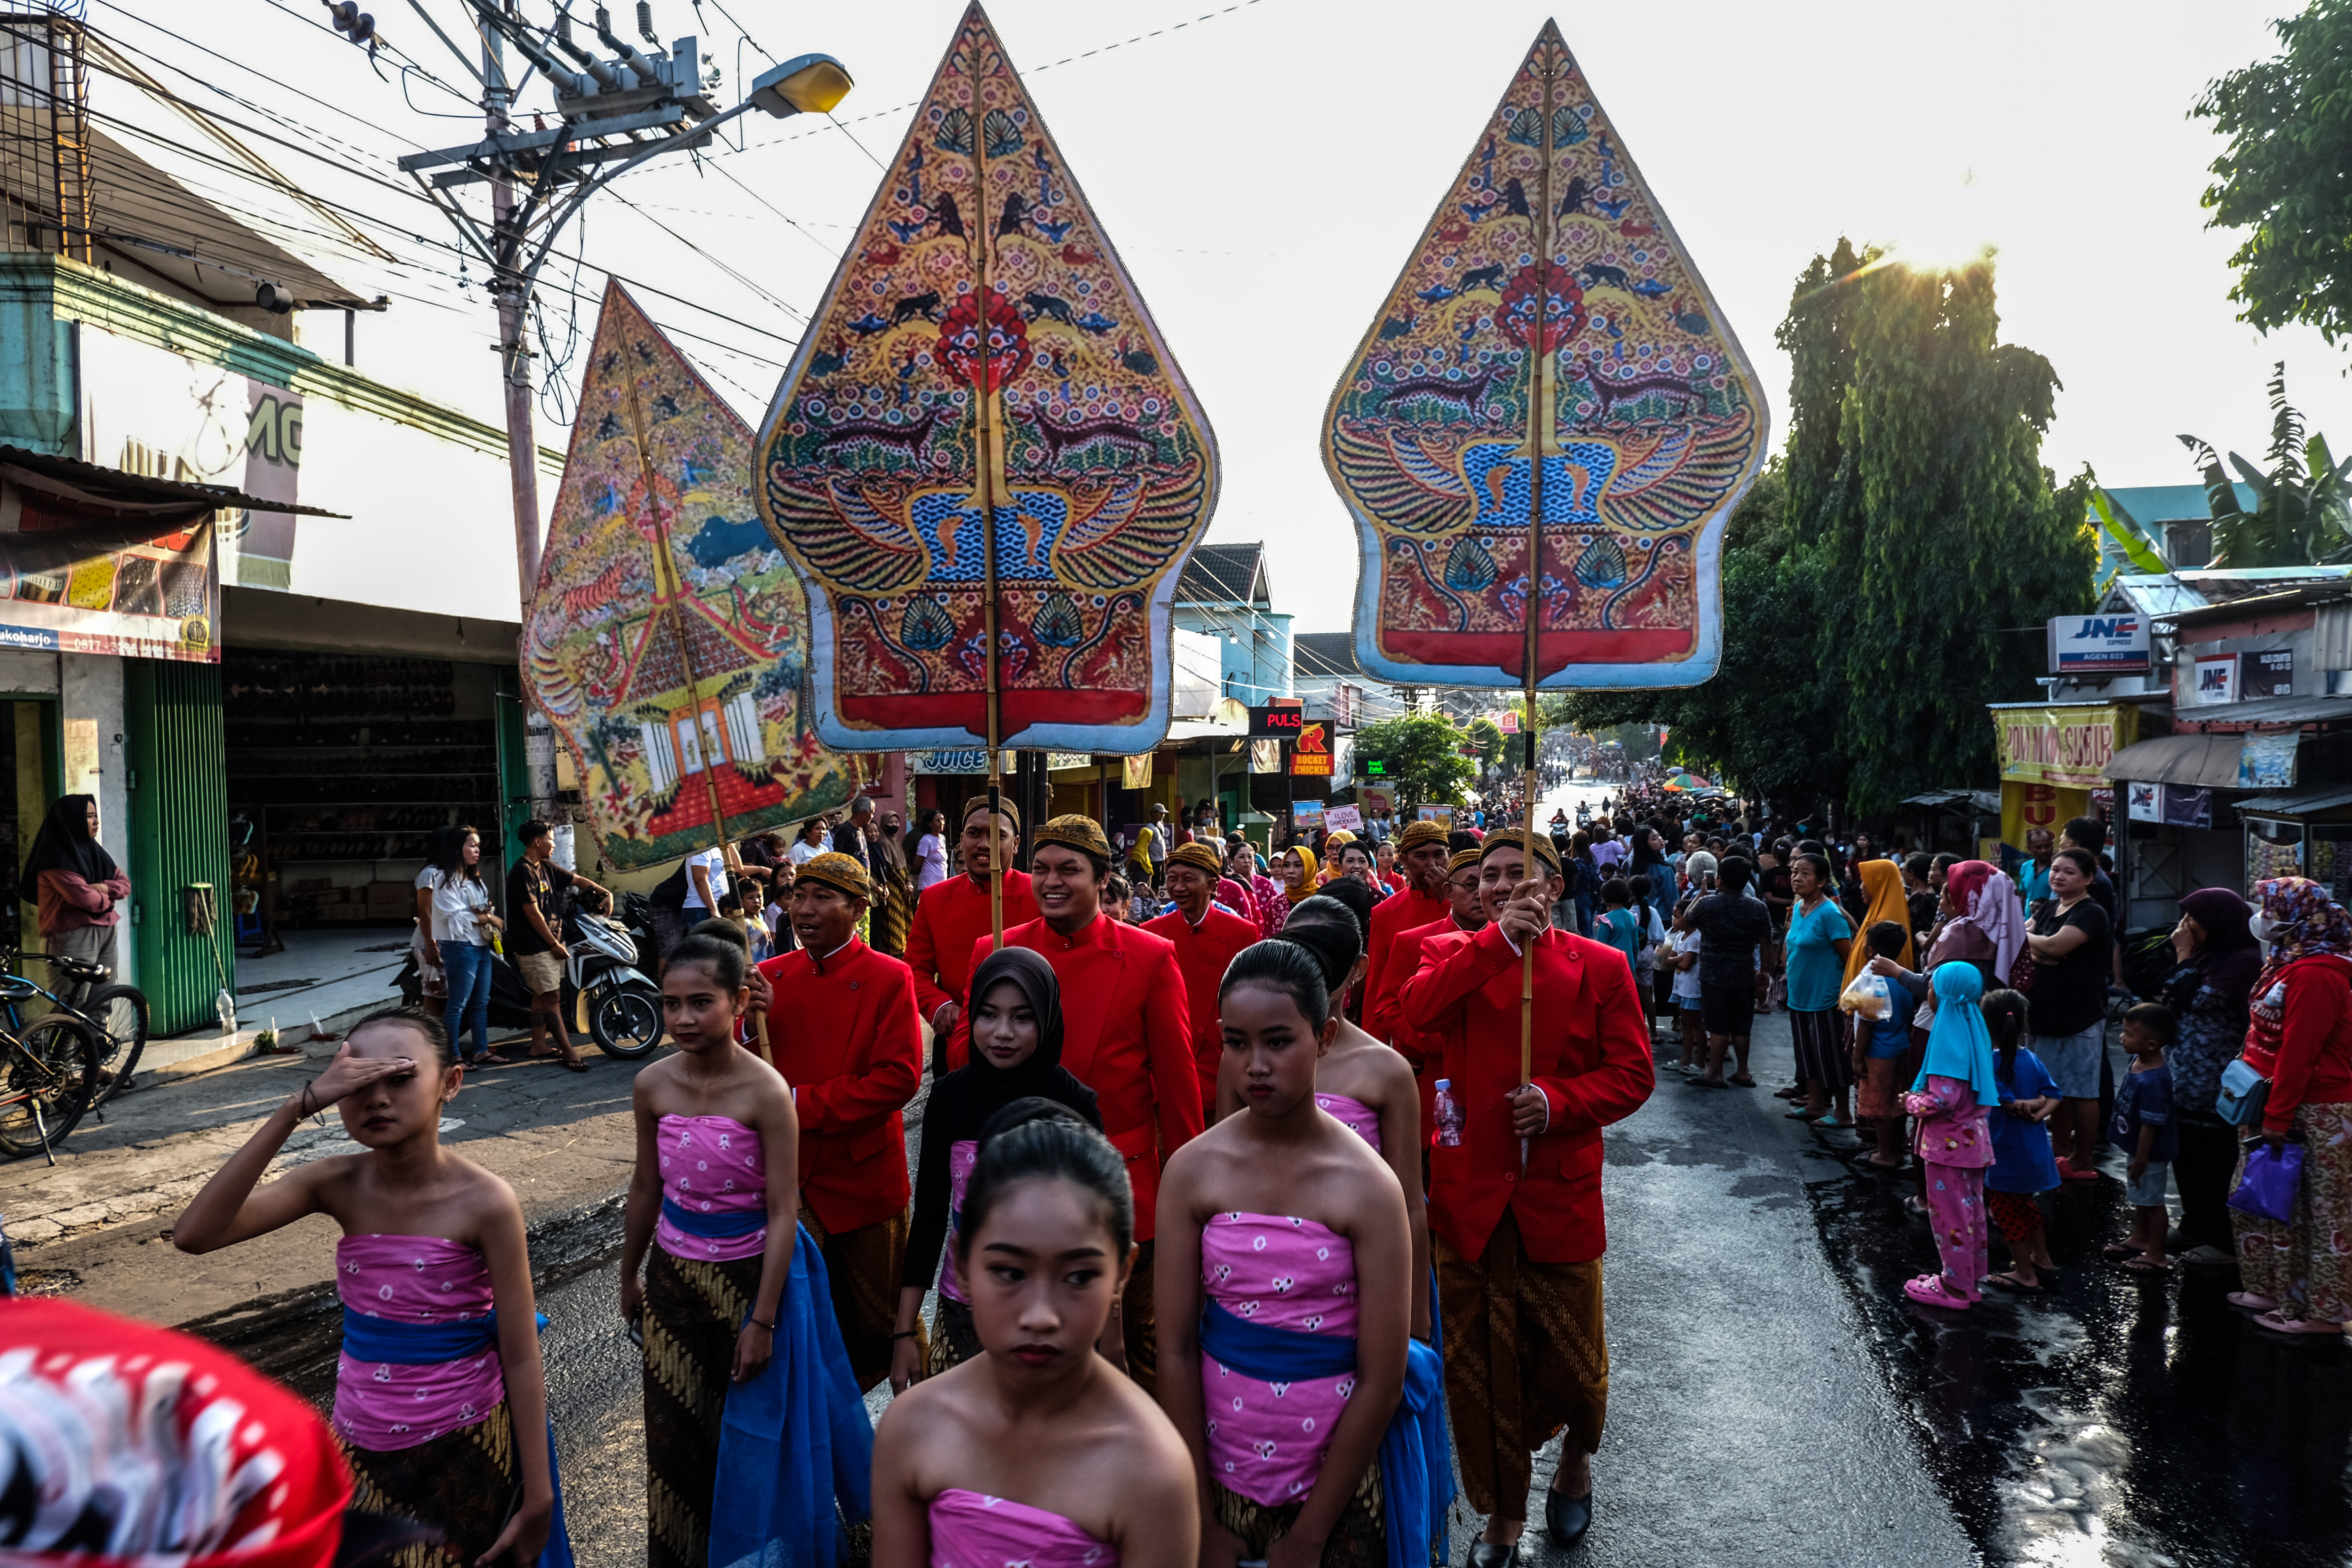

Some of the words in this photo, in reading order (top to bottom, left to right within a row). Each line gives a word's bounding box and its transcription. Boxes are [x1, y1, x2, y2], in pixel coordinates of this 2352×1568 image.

[2074, 617, 2139, 639] JNE
[74, 637, 101, 651] 0877
[2199, 668, 2227, 691] JNE
[1267, 714, 1301, 727] PULS
[2065, 724, 2113, 769] SUBUR
[925, 751, 985, 769] JUICE
[1296, 755, 1328, 764] ROCKET
[1294, 765, 1330, 775] CHICKEN
[1338, 811, 1354, 819] LOVE
